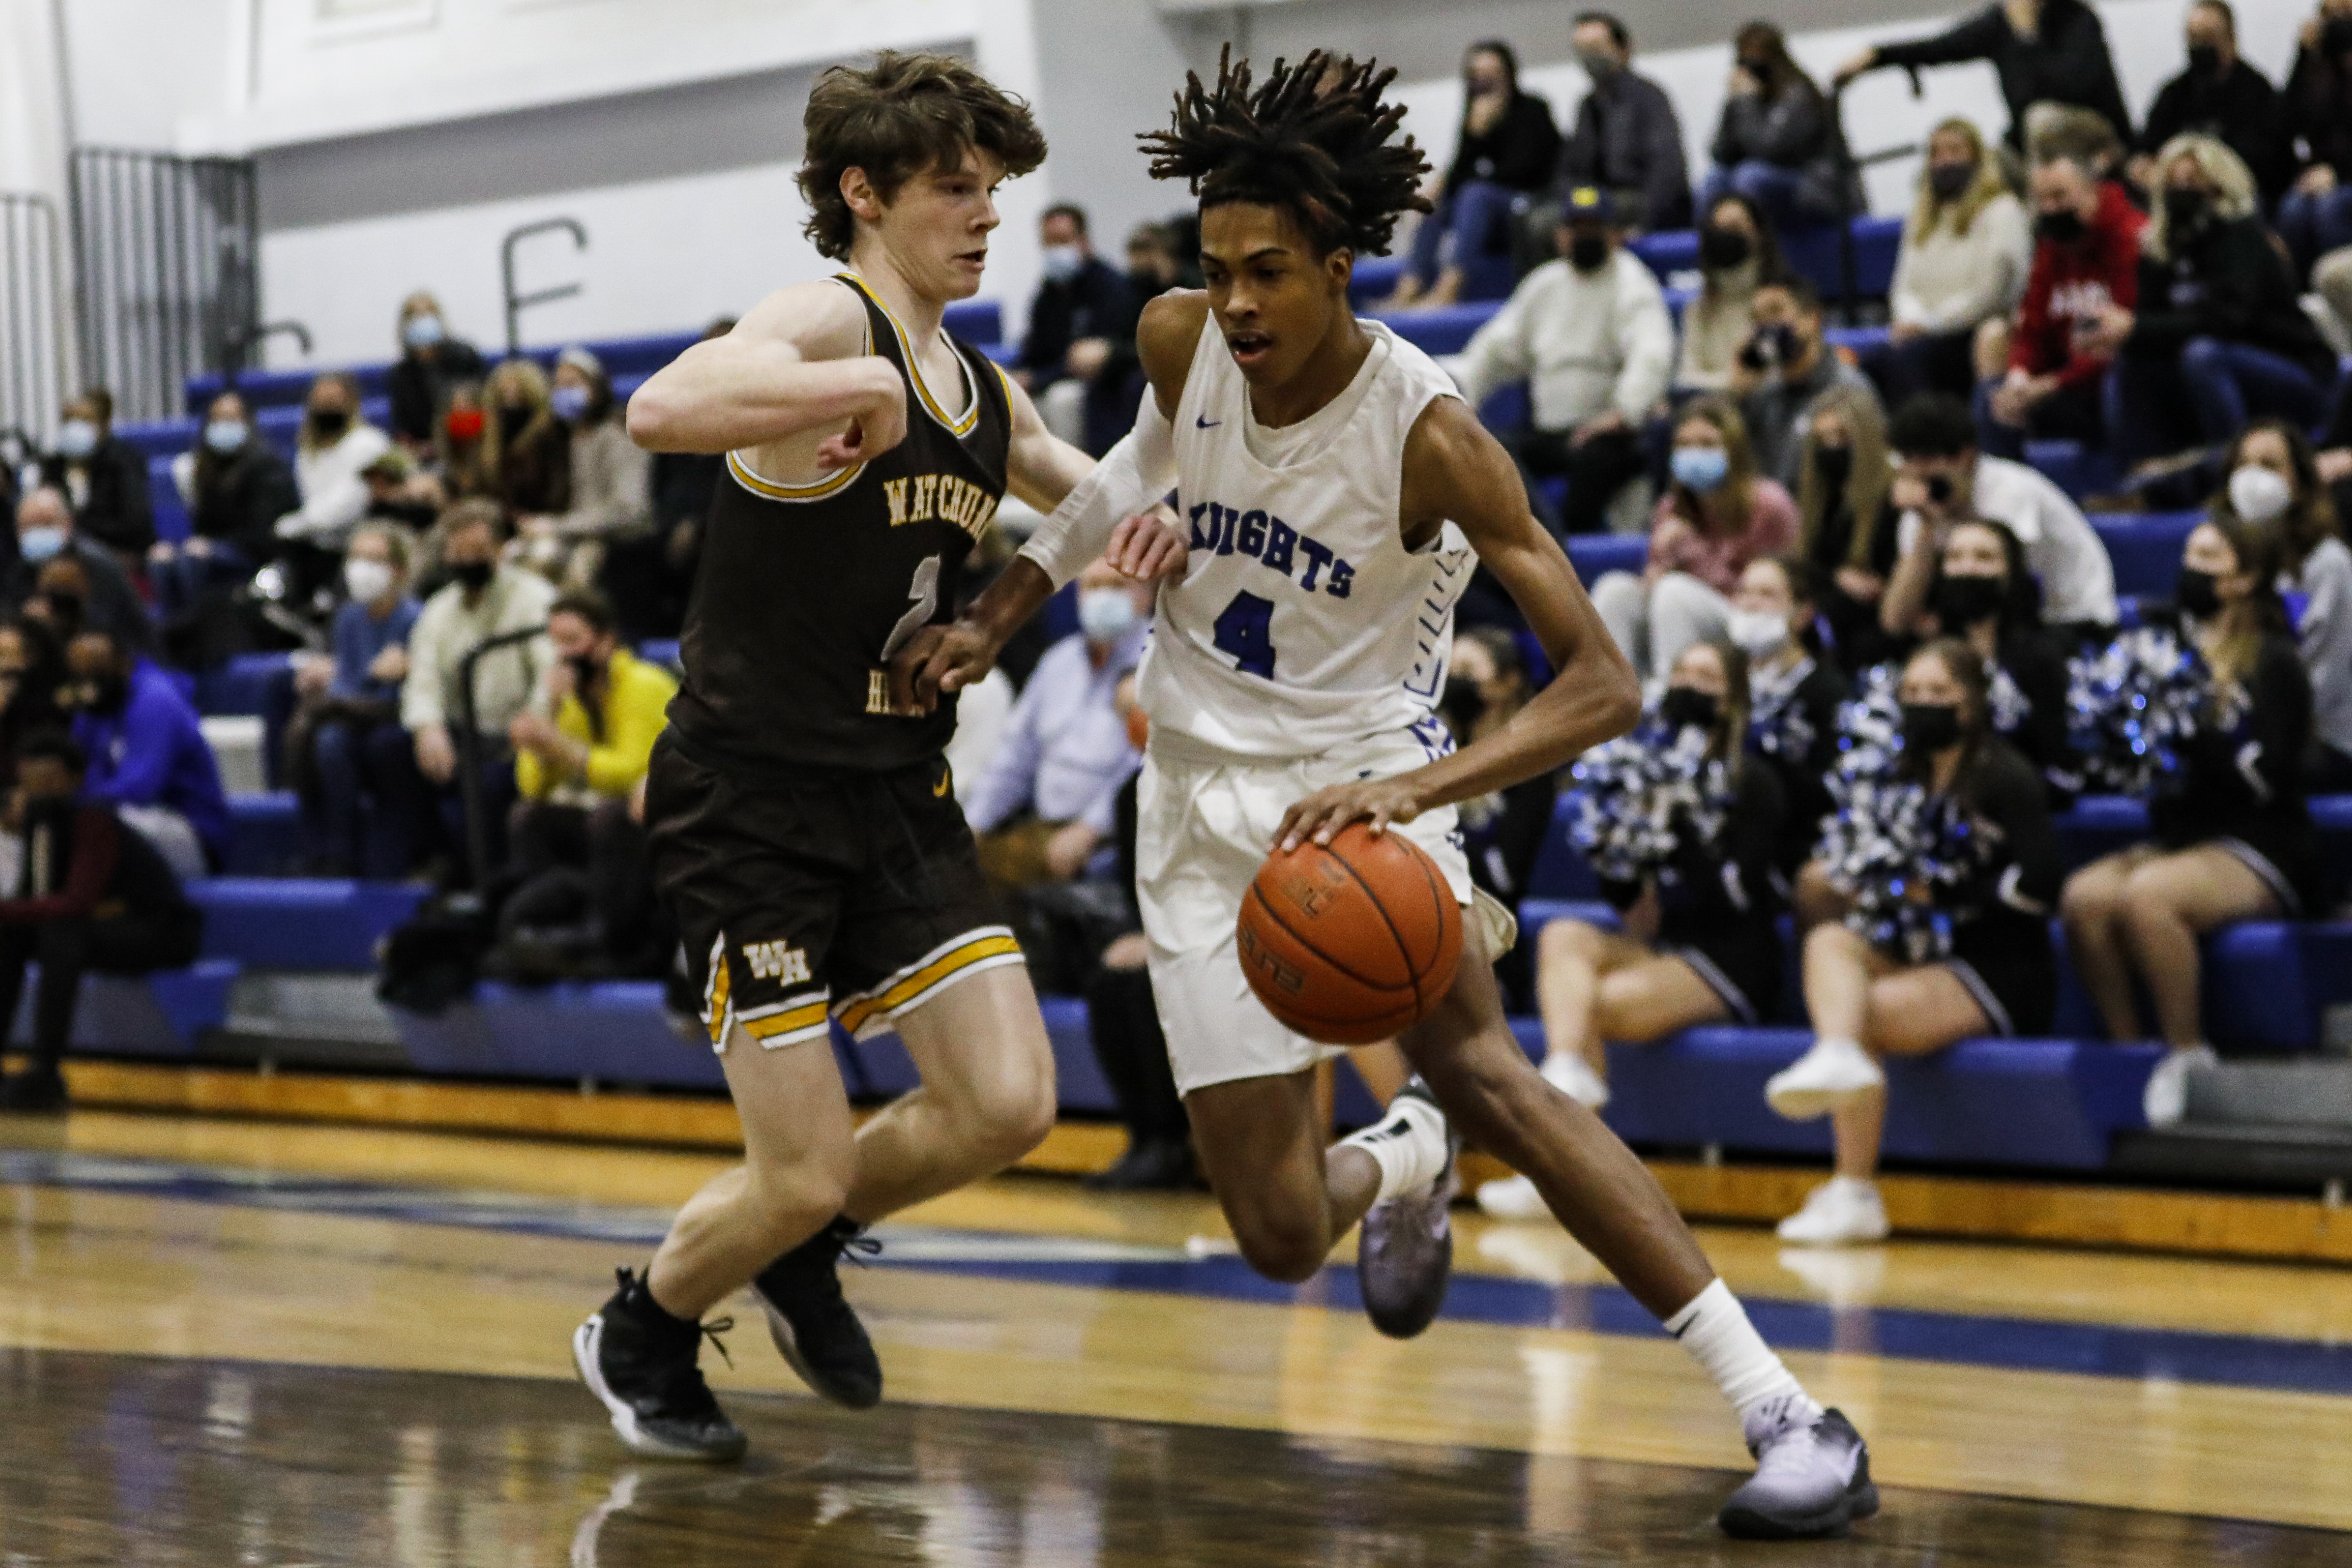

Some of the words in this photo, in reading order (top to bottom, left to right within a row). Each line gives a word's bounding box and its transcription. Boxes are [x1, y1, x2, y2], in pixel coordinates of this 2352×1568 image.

[883, 474, 996, 540] WATCHUN
[881, 554, 941, 662] 2
[1213, 588, 1276, 680] 4
[743, 939, 812, 987] WH
